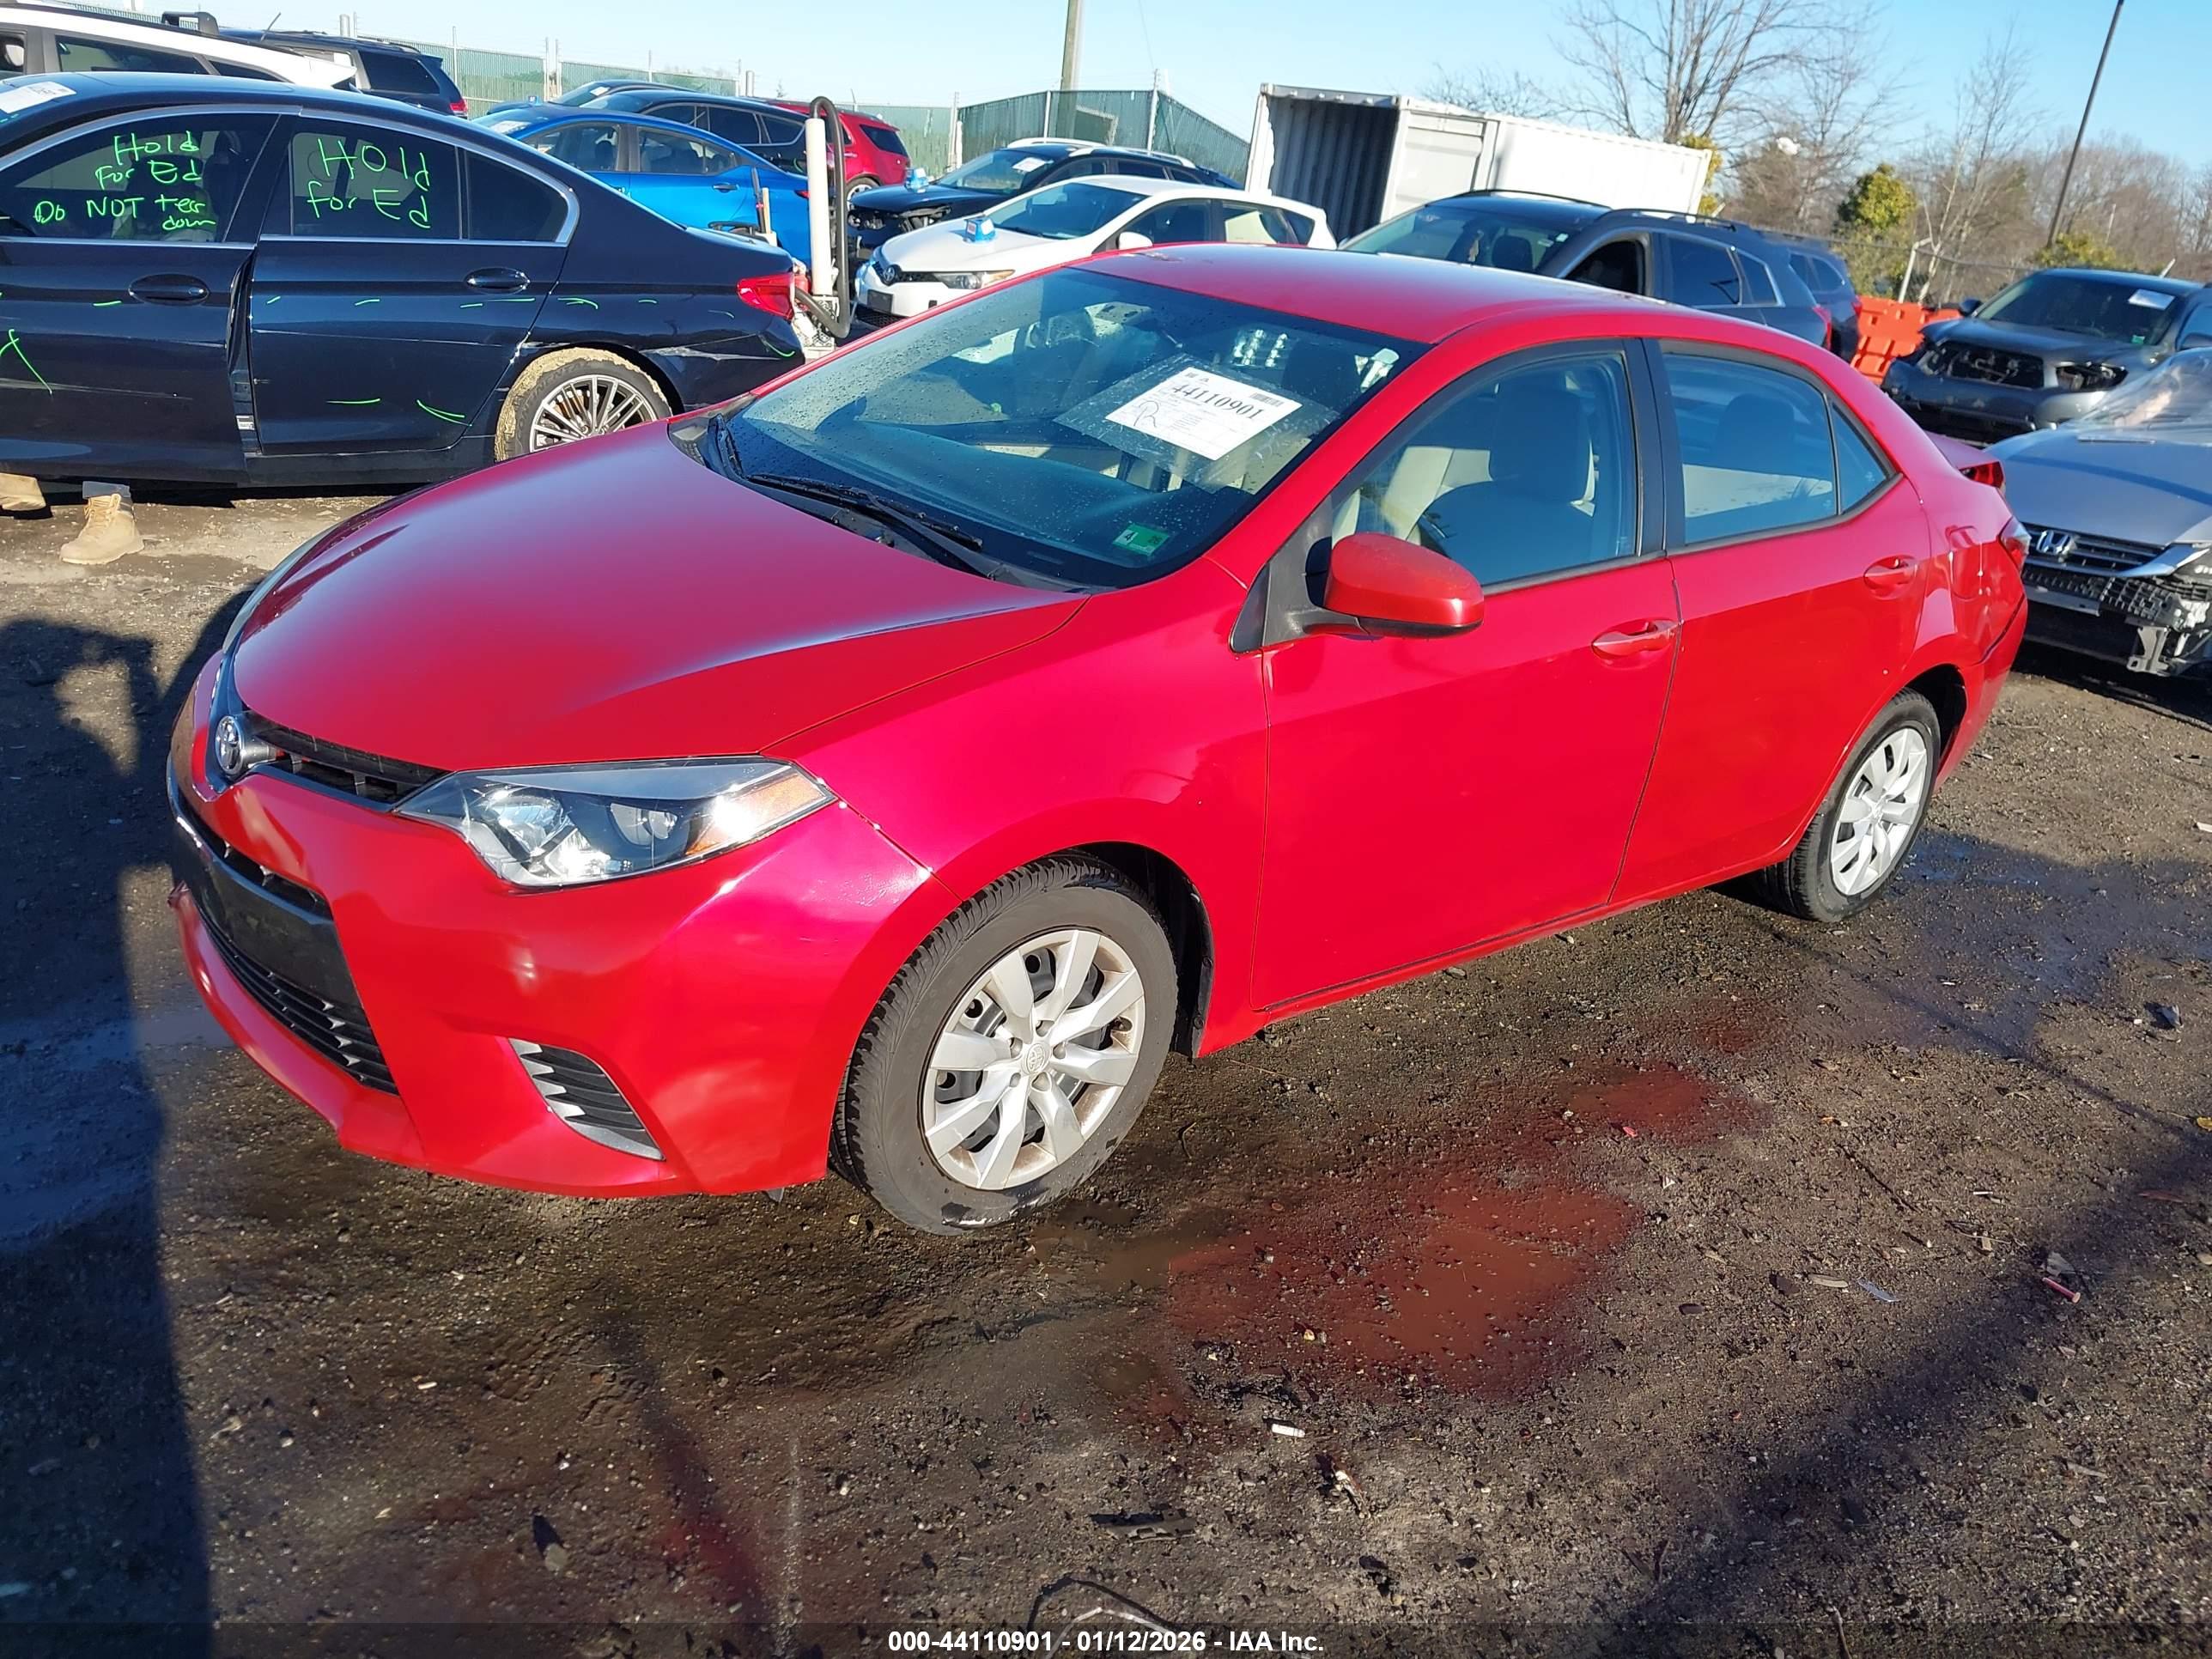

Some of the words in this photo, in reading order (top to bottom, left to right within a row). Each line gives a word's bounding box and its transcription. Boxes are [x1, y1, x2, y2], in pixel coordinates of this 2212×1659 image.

[114, 131, 199, 165] Hold
[147, 159, 202, 184] Ed
[33, 200, 65, 223] Do
[86, 197, 144, 219] NOT
[307, 180, 357, 218] for
[373, 188, 430, 228] Ed
[162, 216, 216, 230] down
[1172, 383, 1265, 420] 44110901
